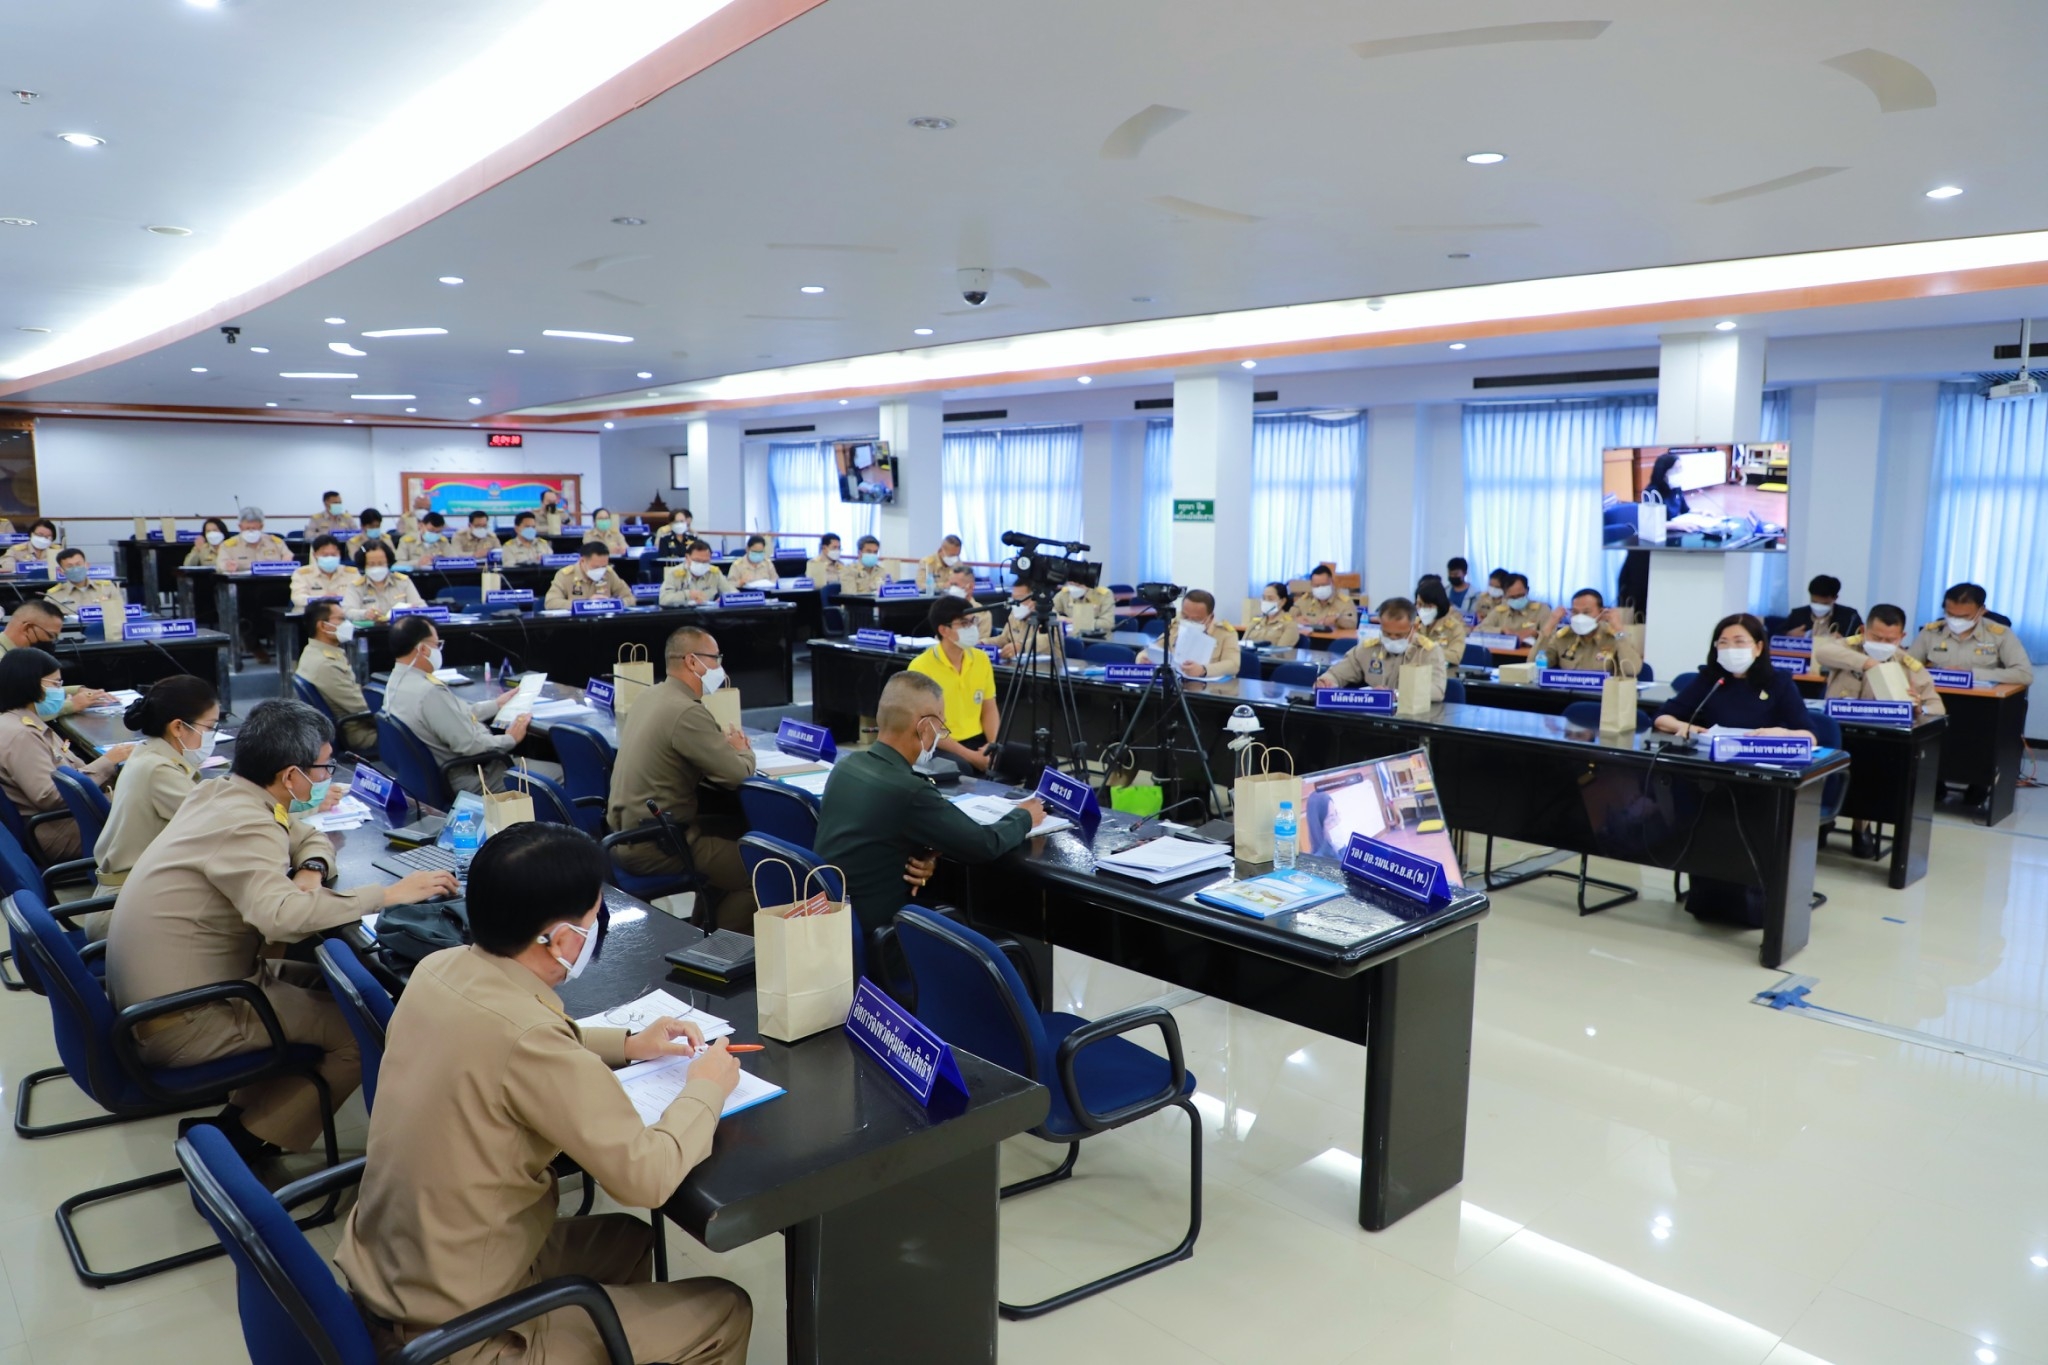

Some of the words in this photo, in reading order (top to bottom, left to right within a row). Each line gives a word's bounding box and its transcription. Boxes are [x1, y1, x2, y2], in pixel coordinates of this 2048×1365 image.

[1331, 692, 1375, 704] ปลัดจังหวัด
[1351, 847, 1363, 860] รอง
[853, 996, 932, 1083] อัยการจังหวัดคุ้มครองสิทธิฯ
